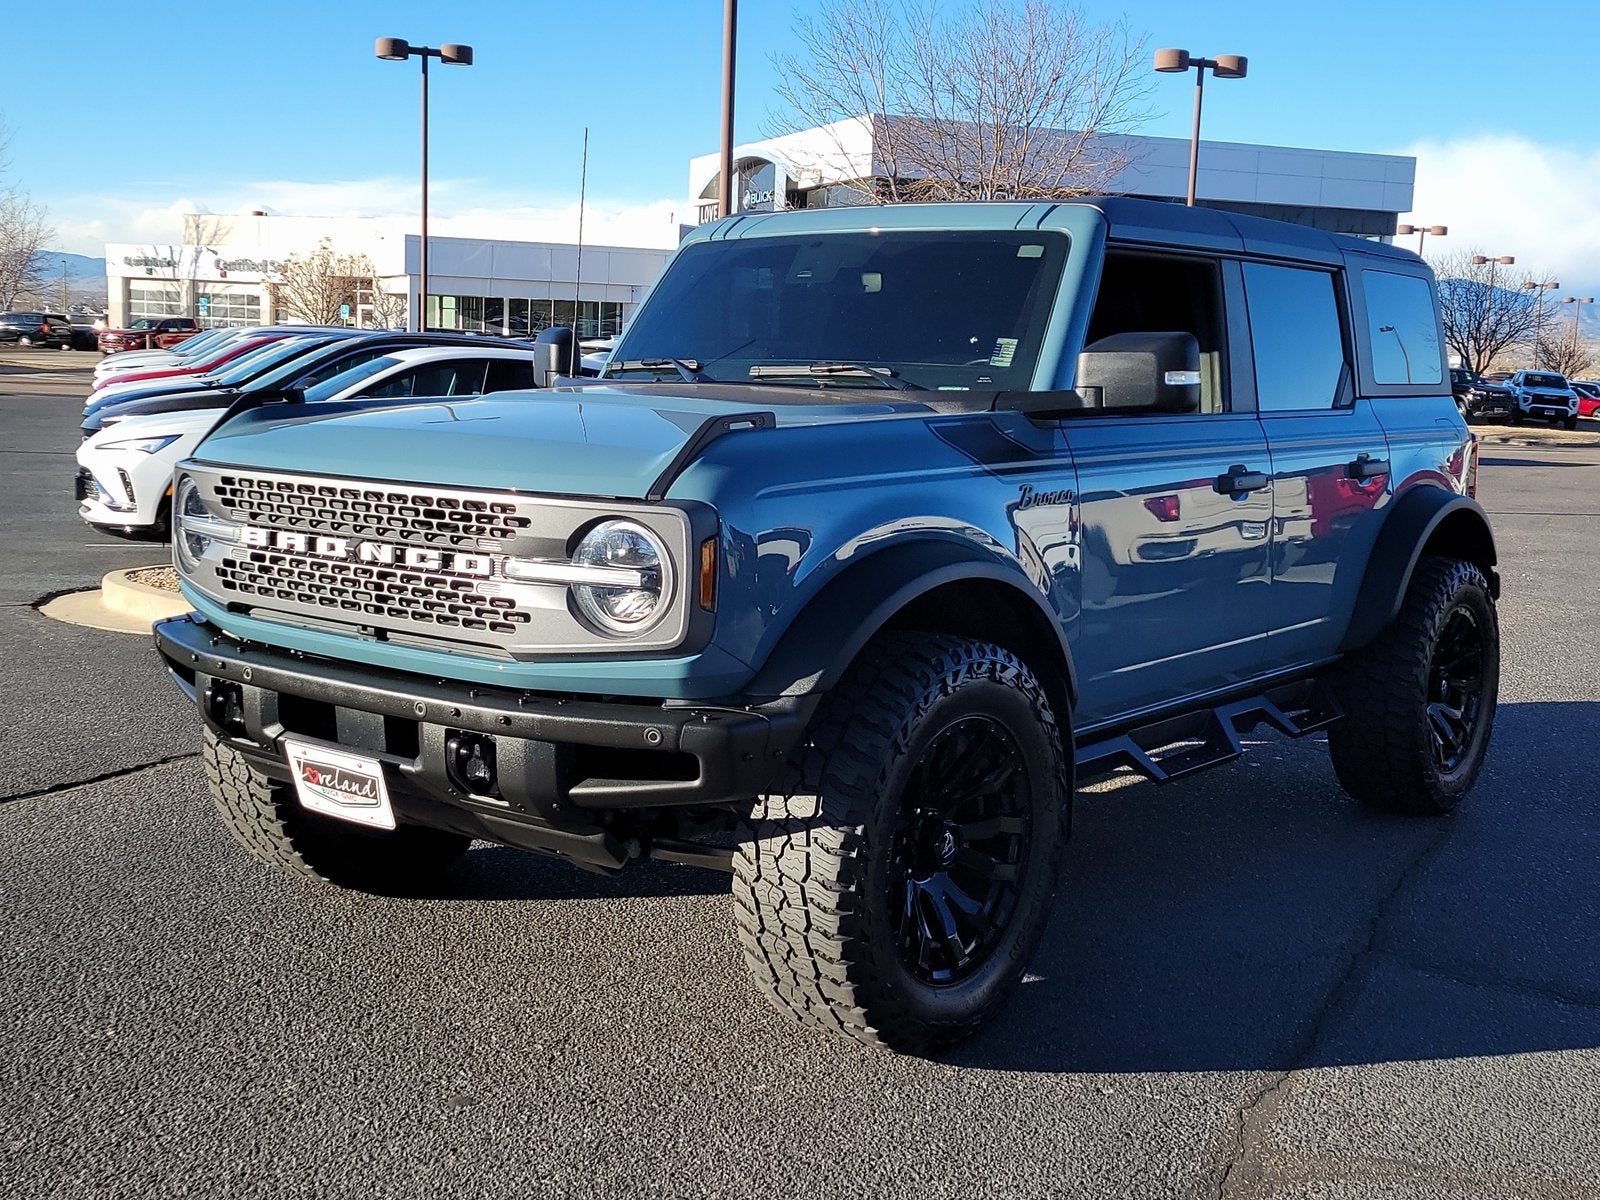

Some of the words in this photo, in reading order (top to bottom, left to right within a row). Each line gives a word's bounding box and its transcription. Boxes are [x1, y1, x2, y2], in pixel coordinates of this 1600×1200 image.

[751, 191, 773, 204] BUICK
[700, 203, 720, 224] LOVE
[1019, 483, 1073, 510] Bronco
[240, 524, 492, 577] BRONCO
